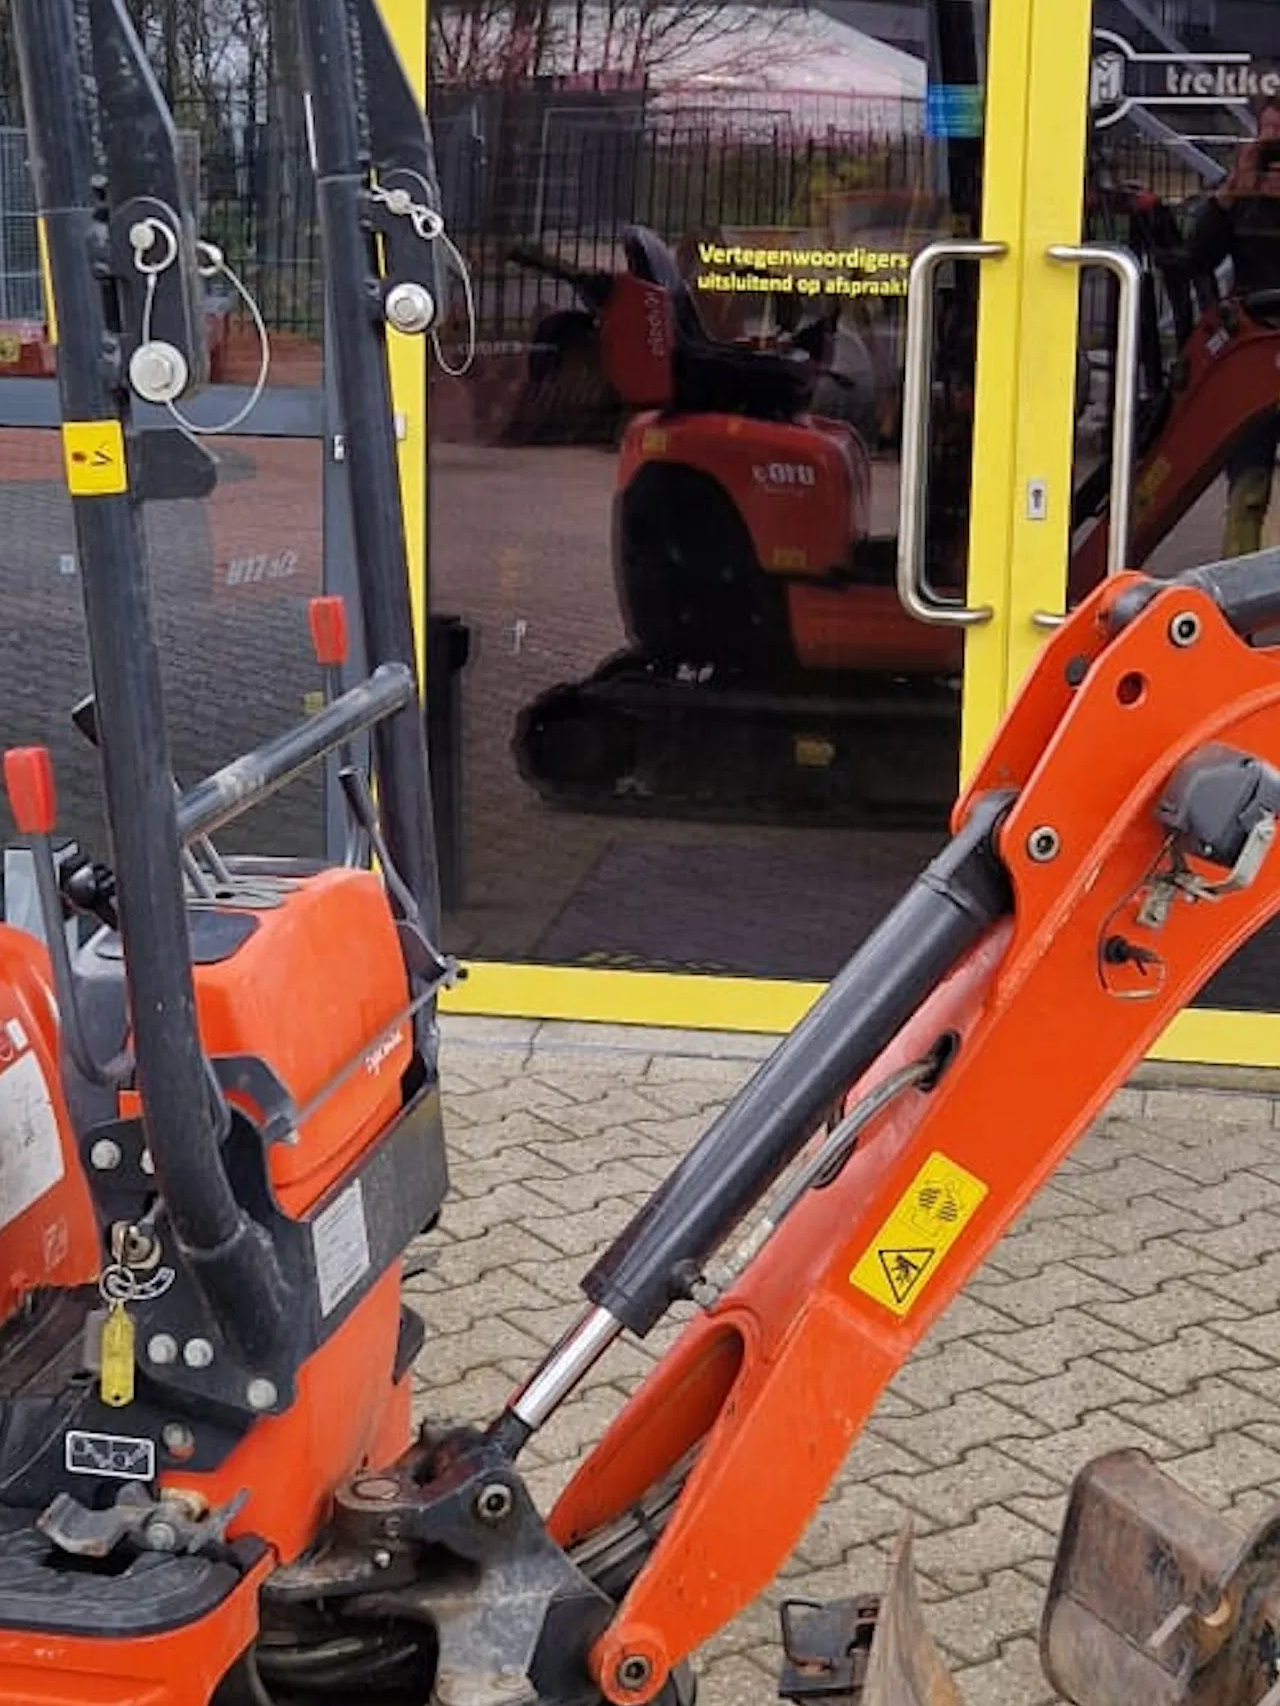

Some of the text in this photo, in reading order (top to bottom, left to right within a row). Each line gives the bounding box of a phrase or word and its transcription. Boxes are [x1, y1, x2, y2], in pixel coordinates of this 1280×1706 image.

[697, 243, 909, 274] Vertegenwoordigers
[697, 271, 908, 298] uitsluitend op afspraak!
